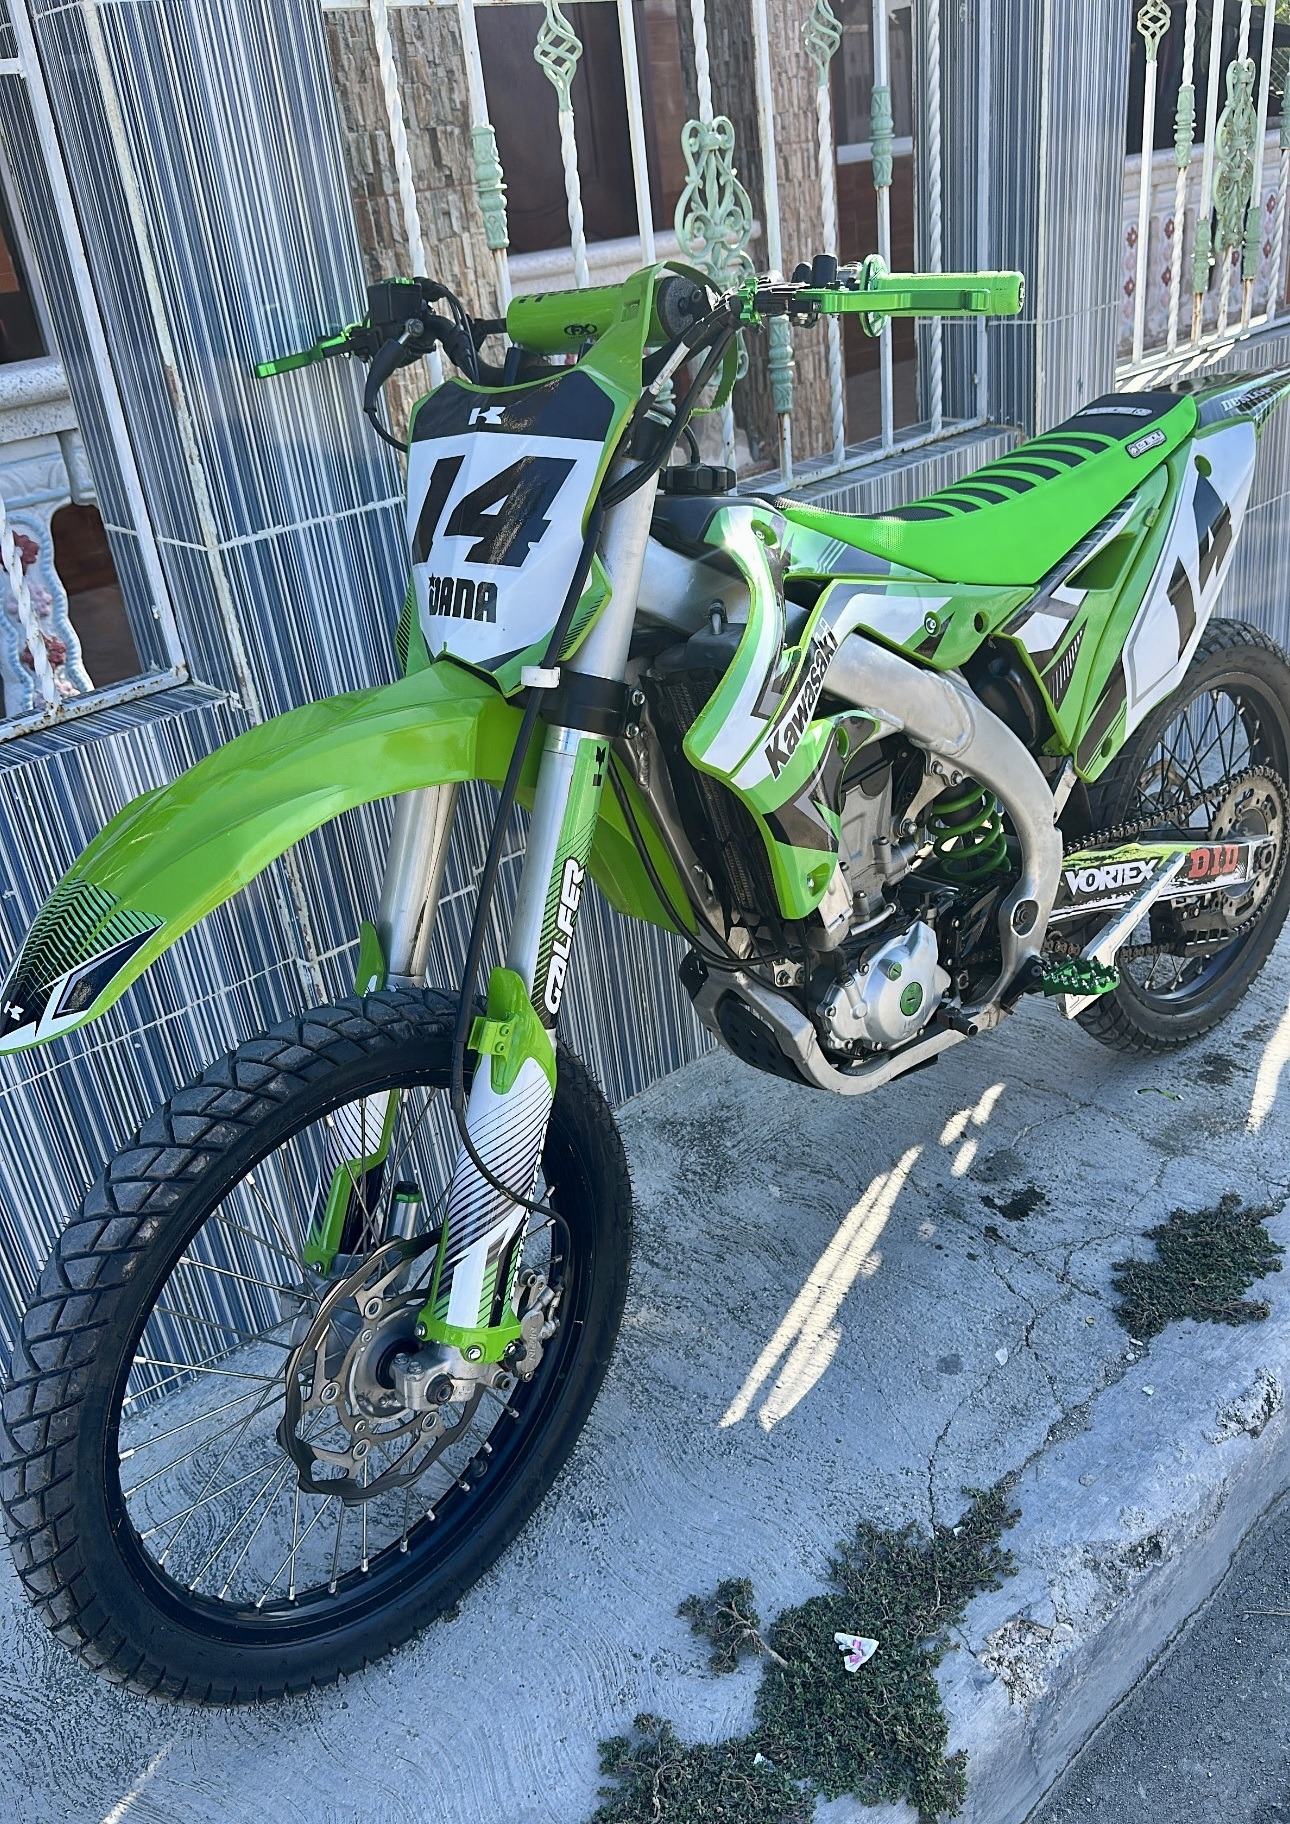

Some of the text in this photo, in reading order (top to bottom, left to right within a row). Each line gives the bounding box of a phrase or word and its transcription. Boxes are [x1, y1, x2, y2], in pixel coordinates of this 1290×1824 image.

[413, 455, 577, 567] 14
[764, 617, 839, 782] Kawasaki
[544, 857, 586, 1015] GALFER
[1065, 858, 1159, 895] VORTEX
